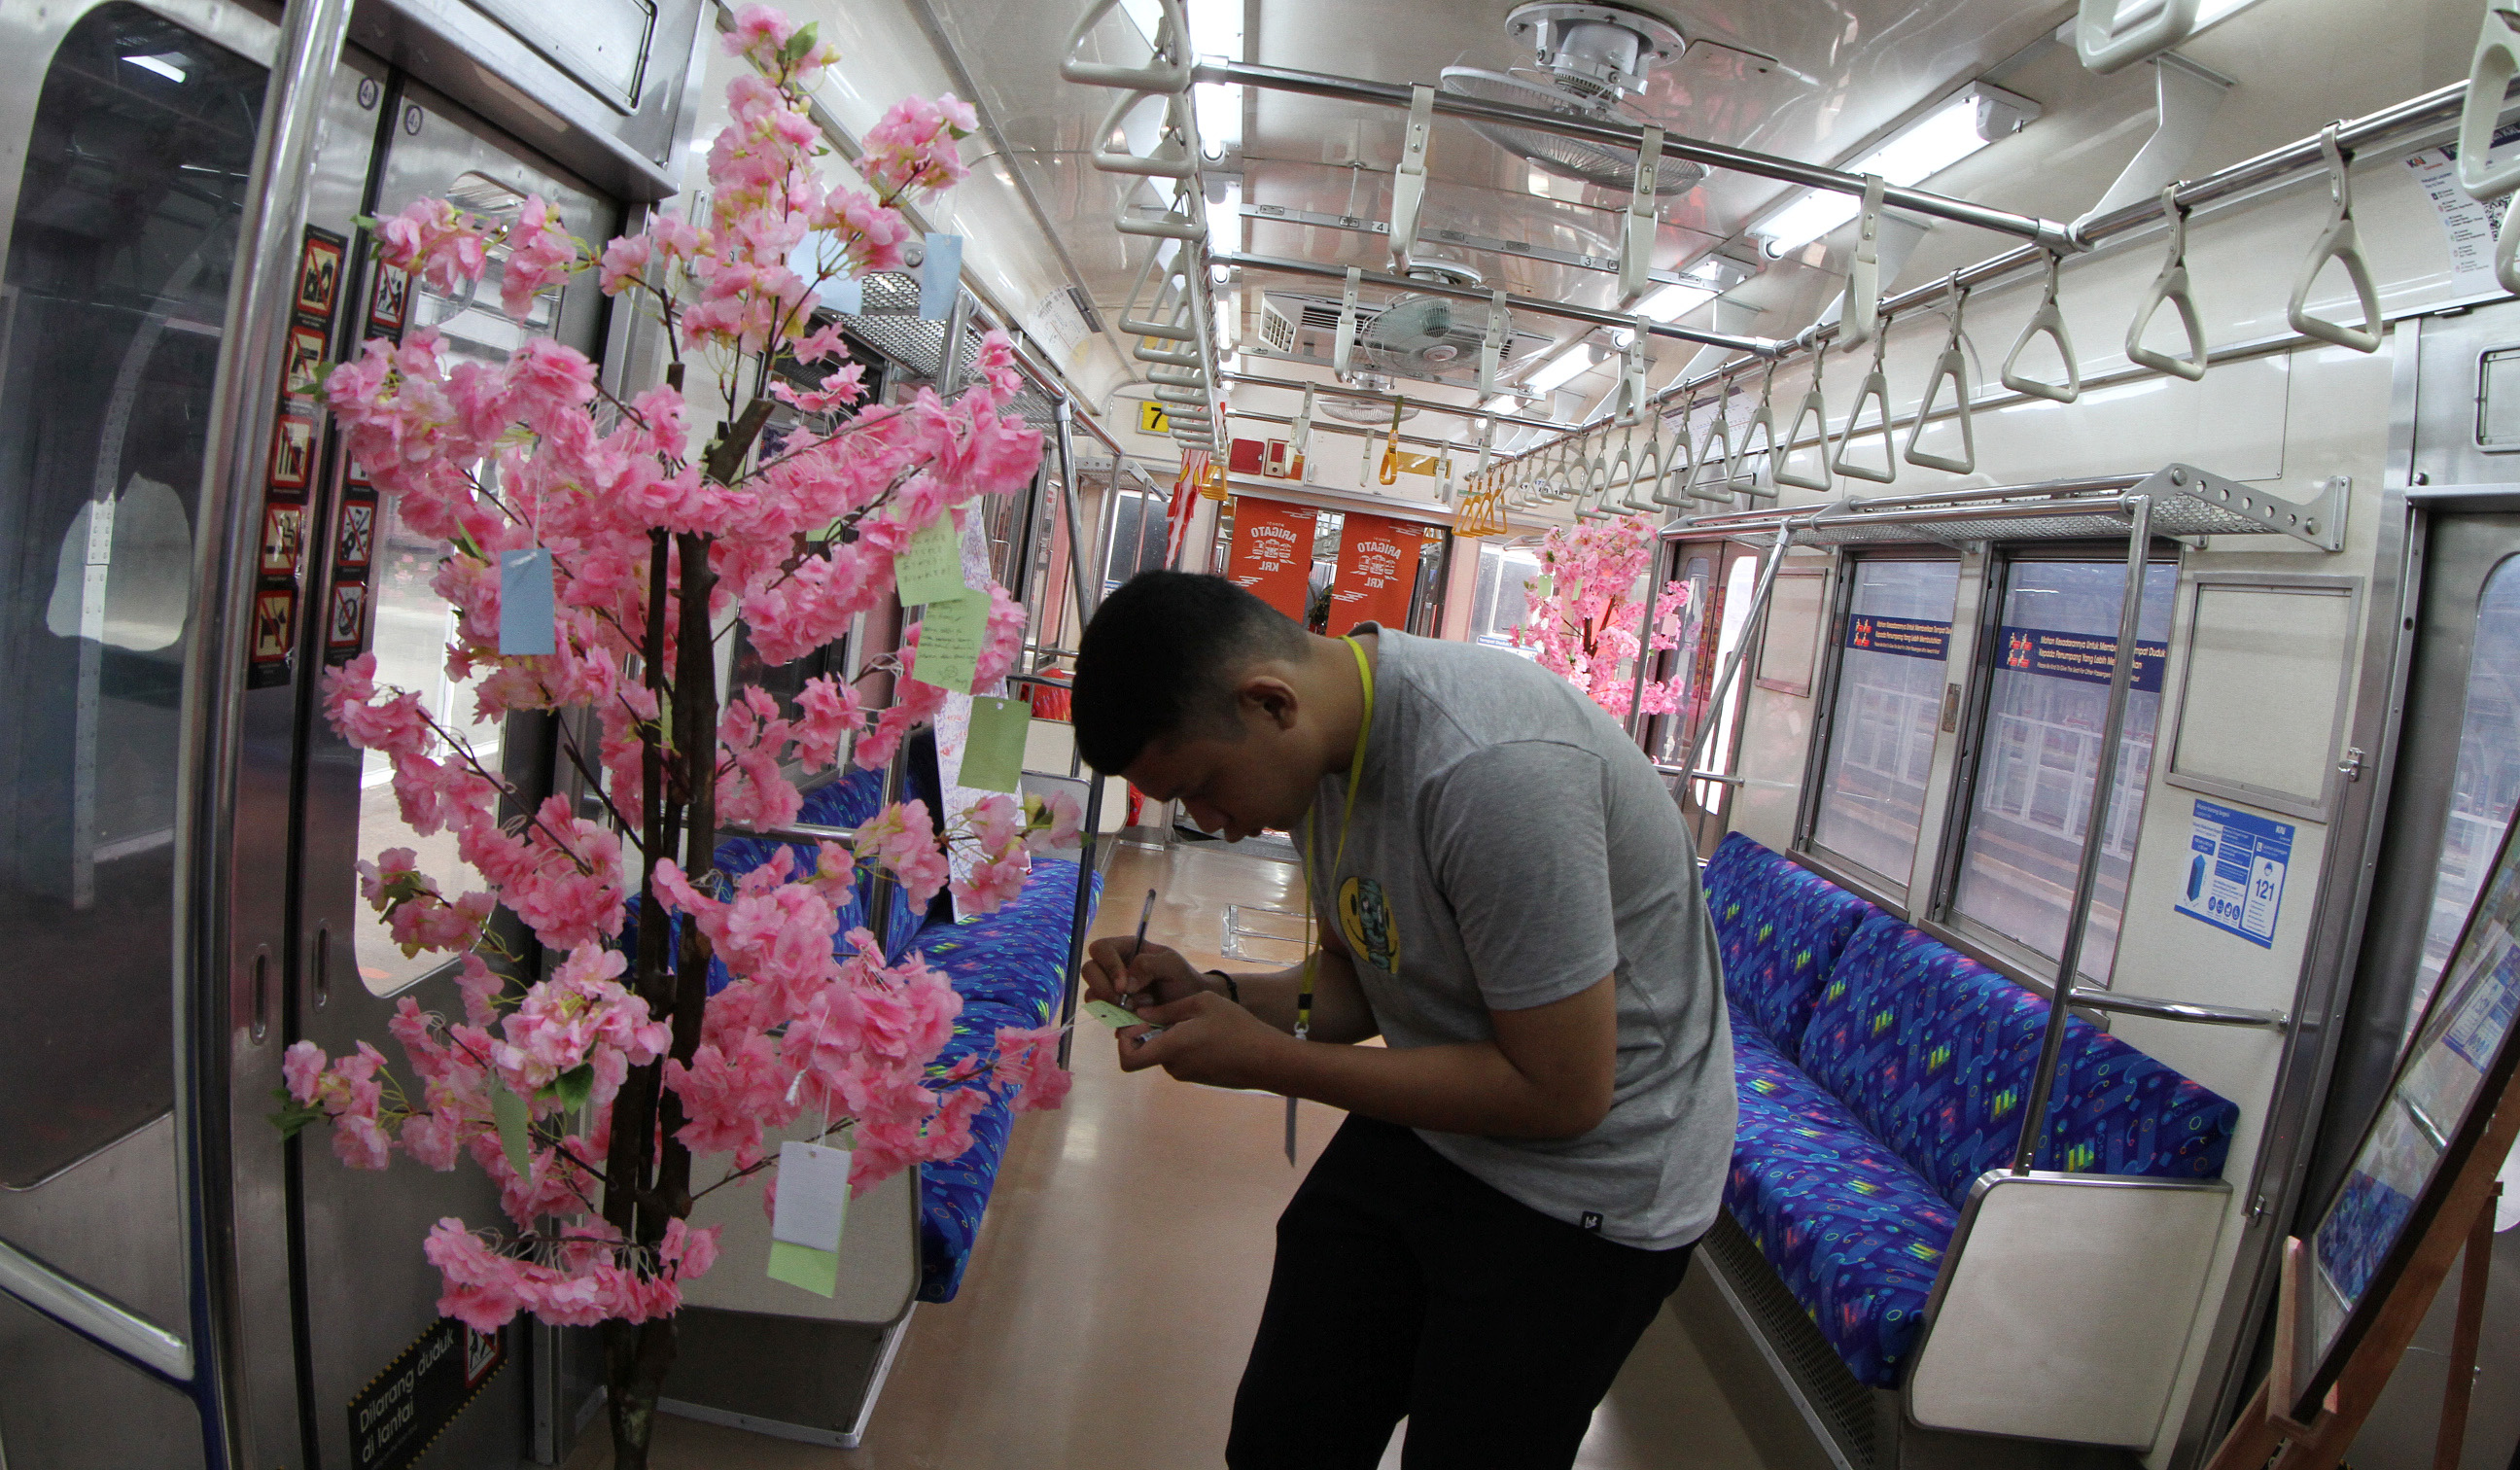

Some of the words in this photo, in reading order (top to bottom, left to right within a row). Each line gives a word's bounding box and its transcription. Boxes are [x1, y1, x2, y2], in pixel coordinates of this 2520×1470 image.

[1377, 223, 1383, 231] 4
[1584, 257, 1592, 266] 3
[1151, 406, 1162, 429] 7
[2056, 650, 2082, 664] Penumpang
[2082, 653, 2094, 665] Yang
[2094, 654, 2107, 665] Lebih
[2149, 647, 2166, 657] Duduk
[2256, 878, 2275, 902] 121
[360, 1368, 414, 1434] Dilarang
[417, 1327, 454, 1377] duduk
[362, 1435, 375, 1463] di
[377, 1395, 414, 1449] lantai
